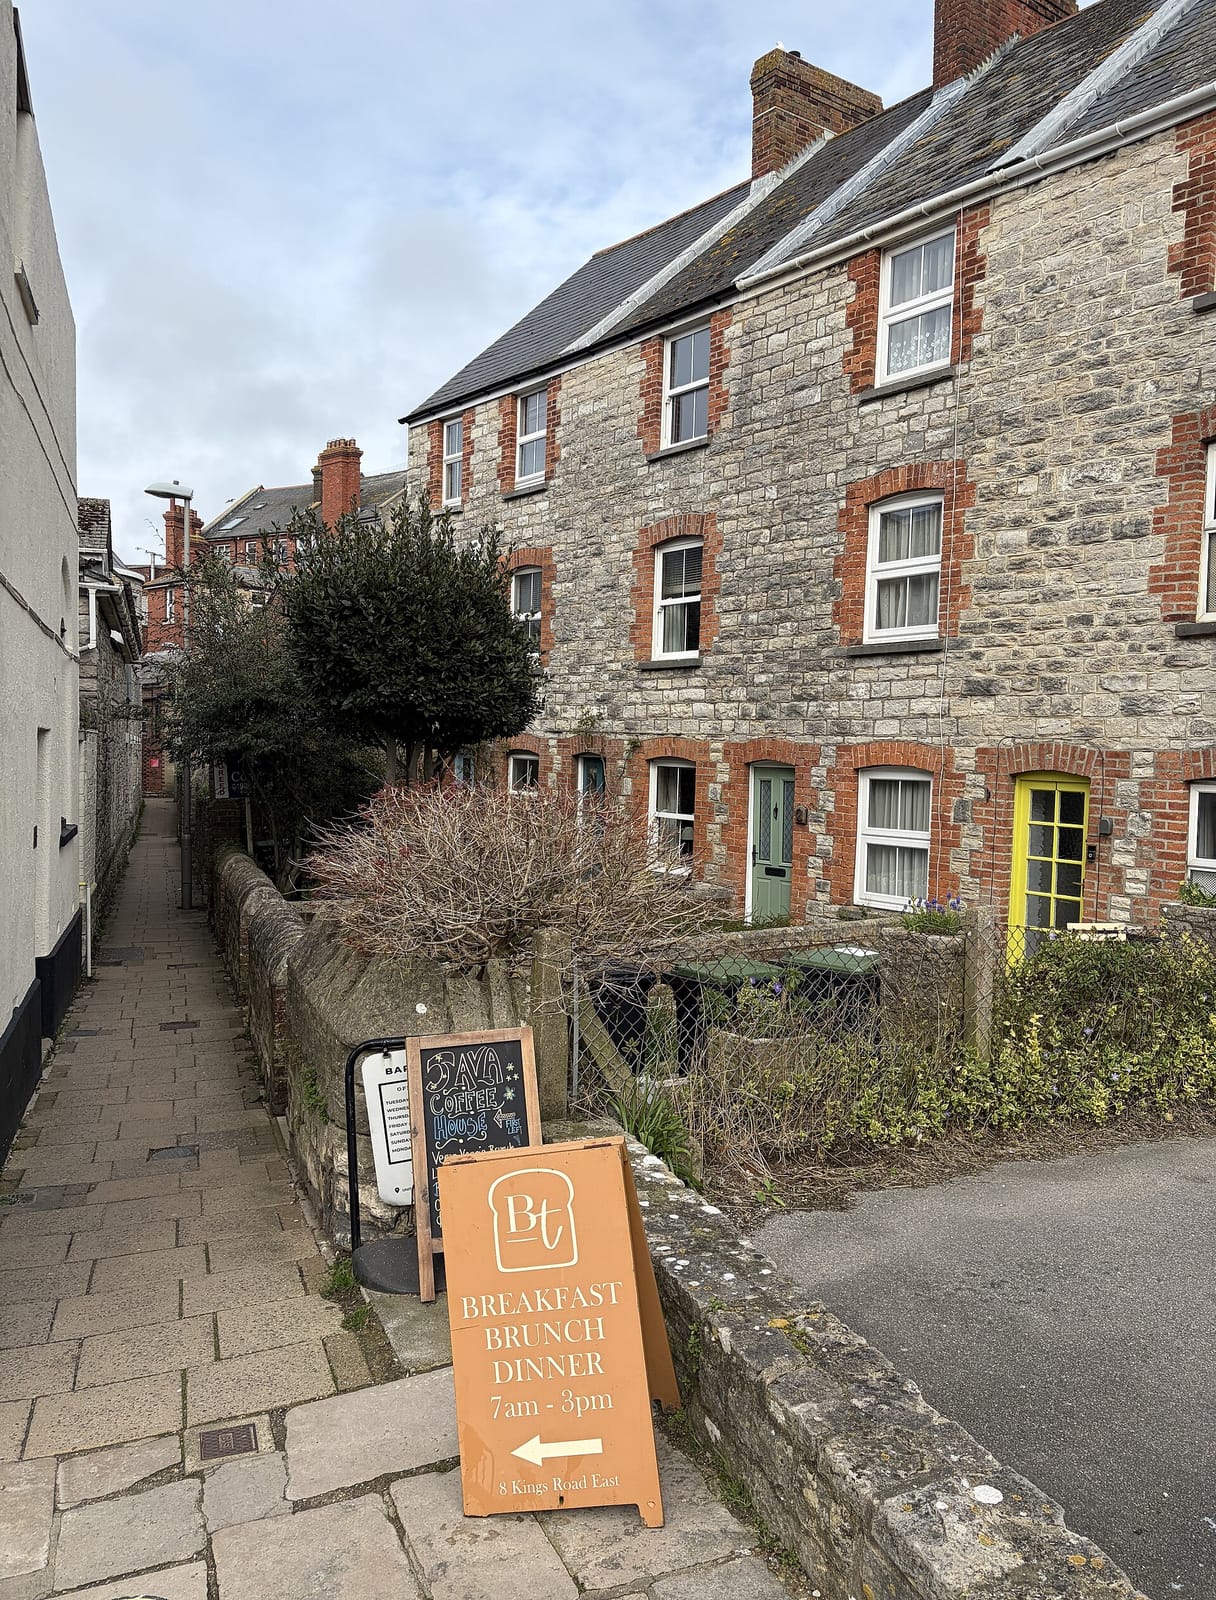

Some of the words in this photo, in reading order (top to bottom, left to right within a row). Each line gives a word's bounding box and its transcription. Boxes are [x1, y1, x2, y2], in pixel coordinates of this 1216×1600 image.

[429, 1087, 498, 1116] COFFEE
[433, 1111, 488, 1140] HOUSE
[507, 1125, 523, 1135] LEFT
[504, 1194, 564, 1250] Bt
[461, 1281, 624, 1319] BREAKFAST
[484, 1317, 606, 1351] BRUNCH
[492, 1351, 605, 1384] DINNER
[490, 1395, 540, 1419] 7am
[560, 1389, 615, 1417] 3pm
[499, 1482, 508, 1496] 8
[511, 1479, 549, 1496] Kings
[552, 1474, 588, 1492] Road
[591, 1473, 621, 1489] East
